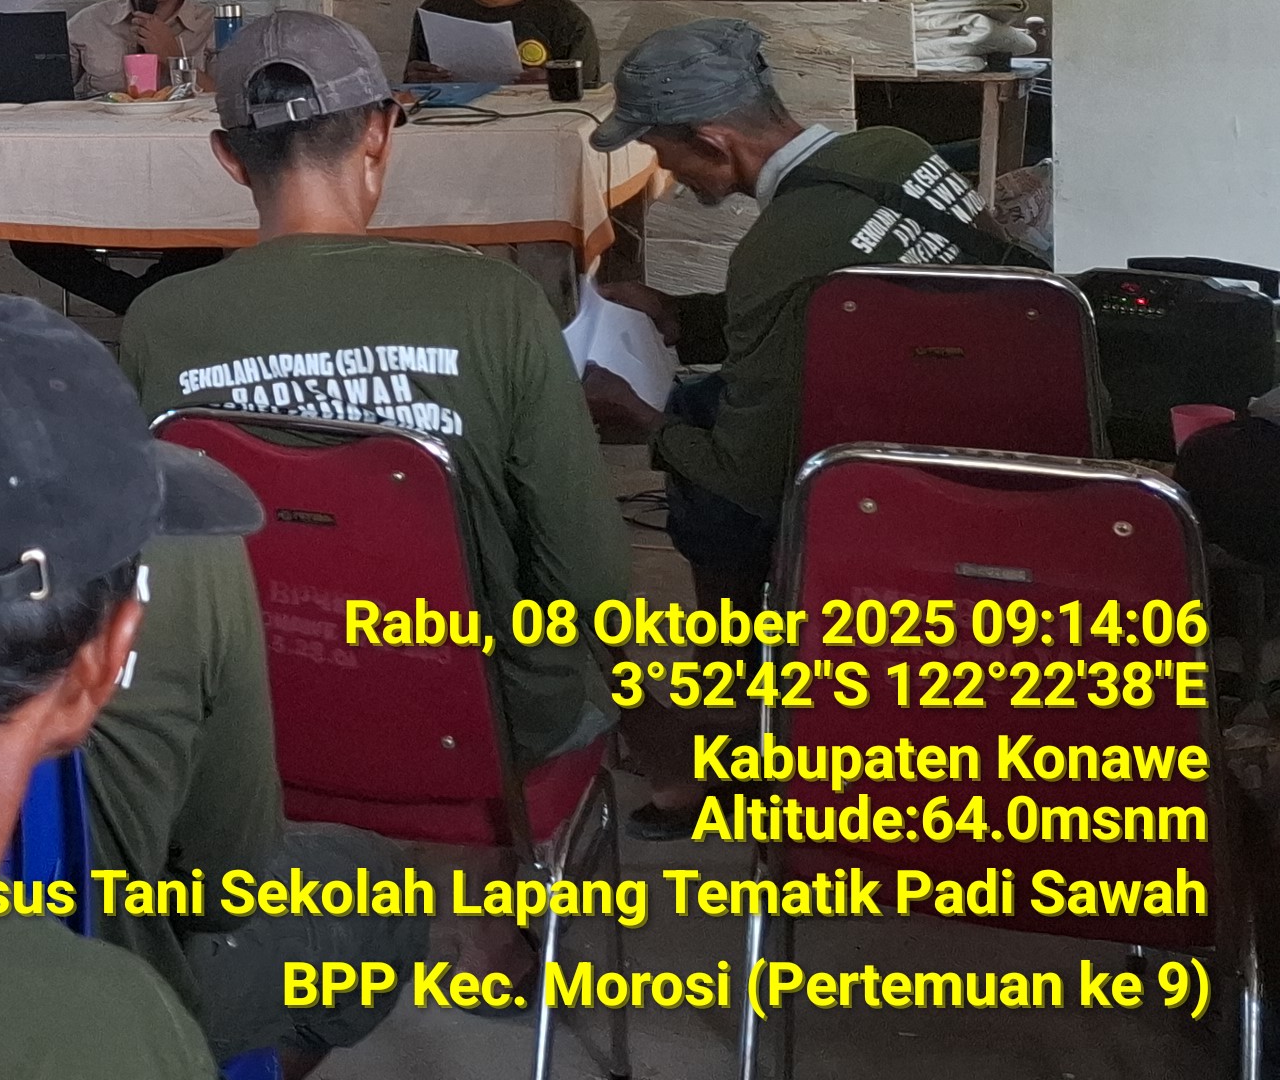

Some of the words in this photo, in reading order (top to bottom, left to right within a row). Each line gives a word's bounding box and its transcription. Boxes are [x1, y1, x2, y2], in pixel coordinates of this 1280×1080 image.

[179, 357, 258, 395] SEKOLAH
[257, 352, 334, 380] LAPANG
[335, 346, 374, 377] (SL)
[376, 345, 459, 376] TEMATIK
